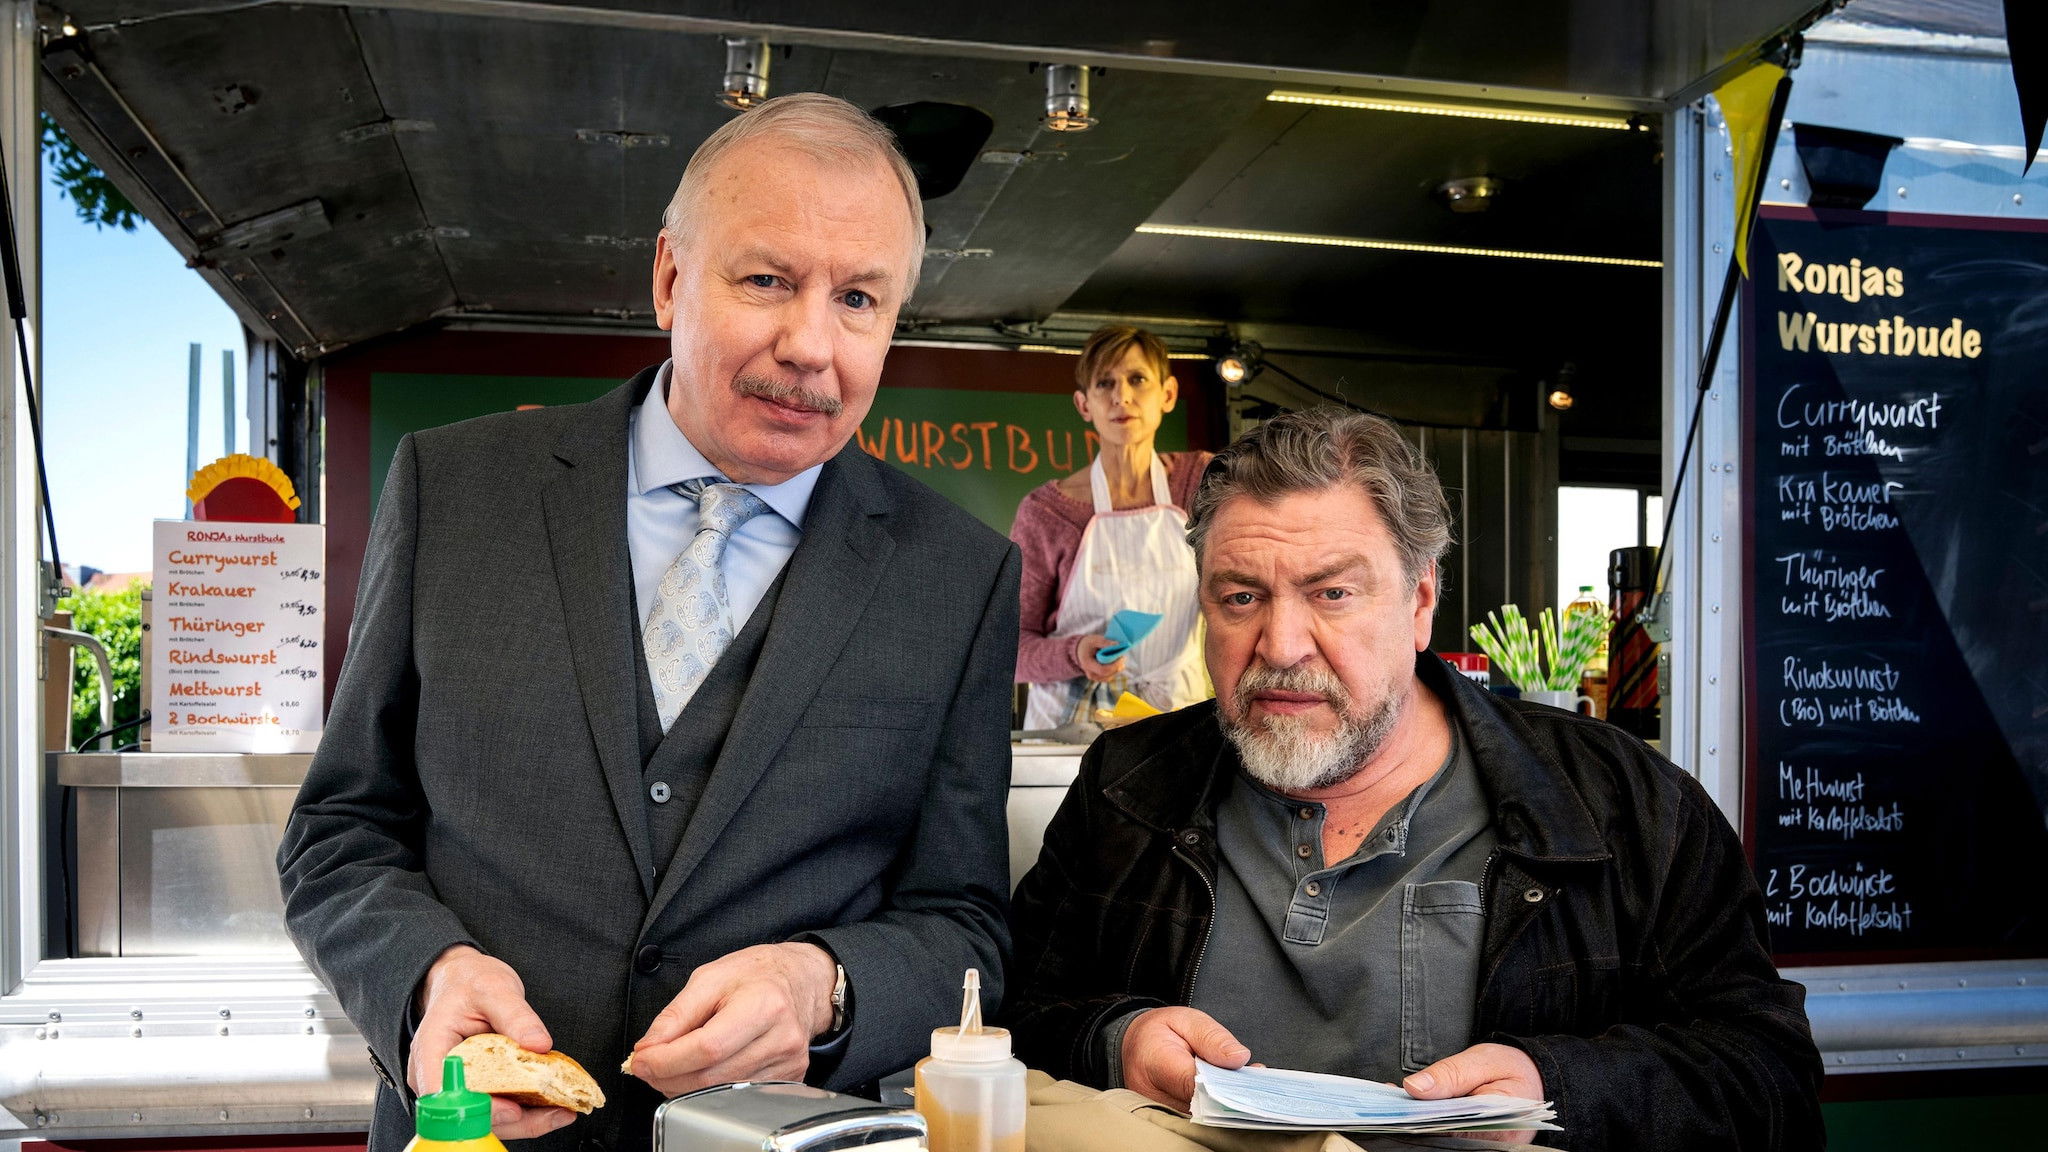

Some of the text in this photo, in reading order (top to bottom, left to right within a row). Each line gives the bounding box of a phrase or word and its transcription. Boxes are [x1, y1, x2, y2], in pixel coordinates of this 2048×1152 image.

[1778, 252, 1904, 303] Ronjas
[1778, 310, 1982, 359] Wurstbude
[1777, 383, 1942, 434] Currywurst
[1781, 429, 1904, 463] mit Brötchen
[1779, 471, 1904, 504] Krakauer
[1781, 502, 1899, 532] mit Brötchen
[187, 531, 286, 544] RONJAs Wurstbude
[168, 550, 278, 573] Currywurst
[1775, 549, 1885, 590] Thüringer
[168, 581, 256, 597] Krakauer
[1781, 591, 1820, 618] mit
[168, 616, 265, 637] Thüringer
[169, 648, 277, 665] Rindswurst
[1783, 656, 1900, 692] Rindswurst
[169, 681, 262, 697] Mettwurst
[169, 711, 280, 725] 2 Bockwürste
[1780, 697, 1825, 727] (Bio)
[1829, 696, 1863, 722] mit
[1779, 761, 1865, 804] Mettwurst
[1779, 807, 1802, 827] mit
[1766, 869, 1779, 897] 2
[1766, 902, 1793, 928] mit
